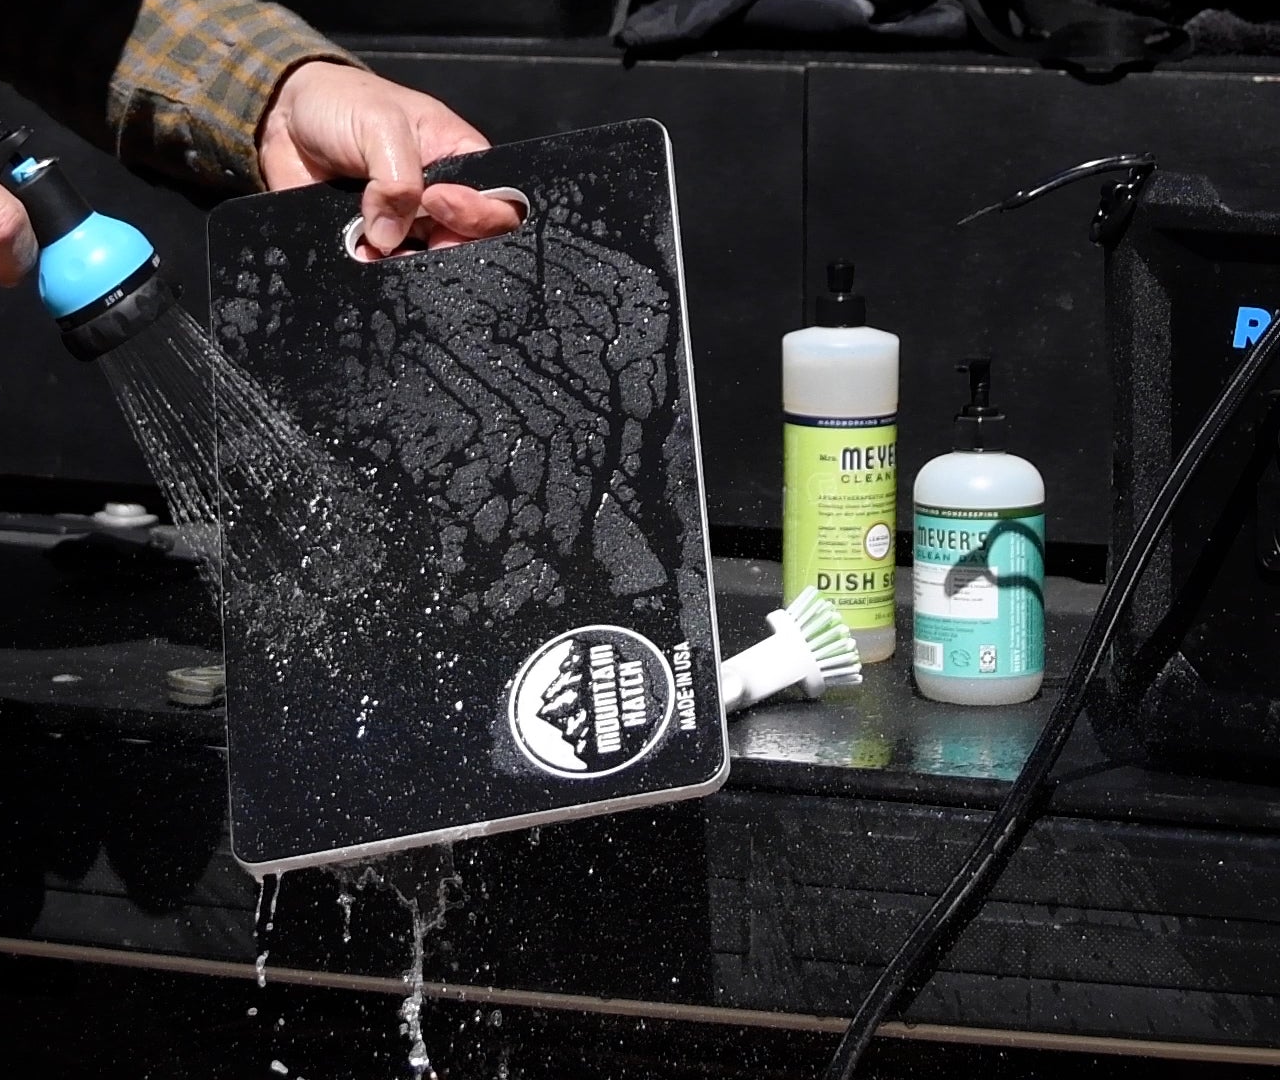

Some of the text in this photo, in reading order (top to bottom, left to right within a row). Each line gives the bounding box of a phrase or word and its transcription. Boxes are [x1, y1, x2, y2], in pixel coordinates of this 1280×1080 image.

[841, 443, 898, 471] MEYE
[917, 525, 988, 551] MEYER'S
[816, 572, 876, 591] DISH
[589, 644, 621, 754] MOUNTAIN
[619, 660, 647, 727] HATCH
[673, 640, 697, 730] MADE IN USA
